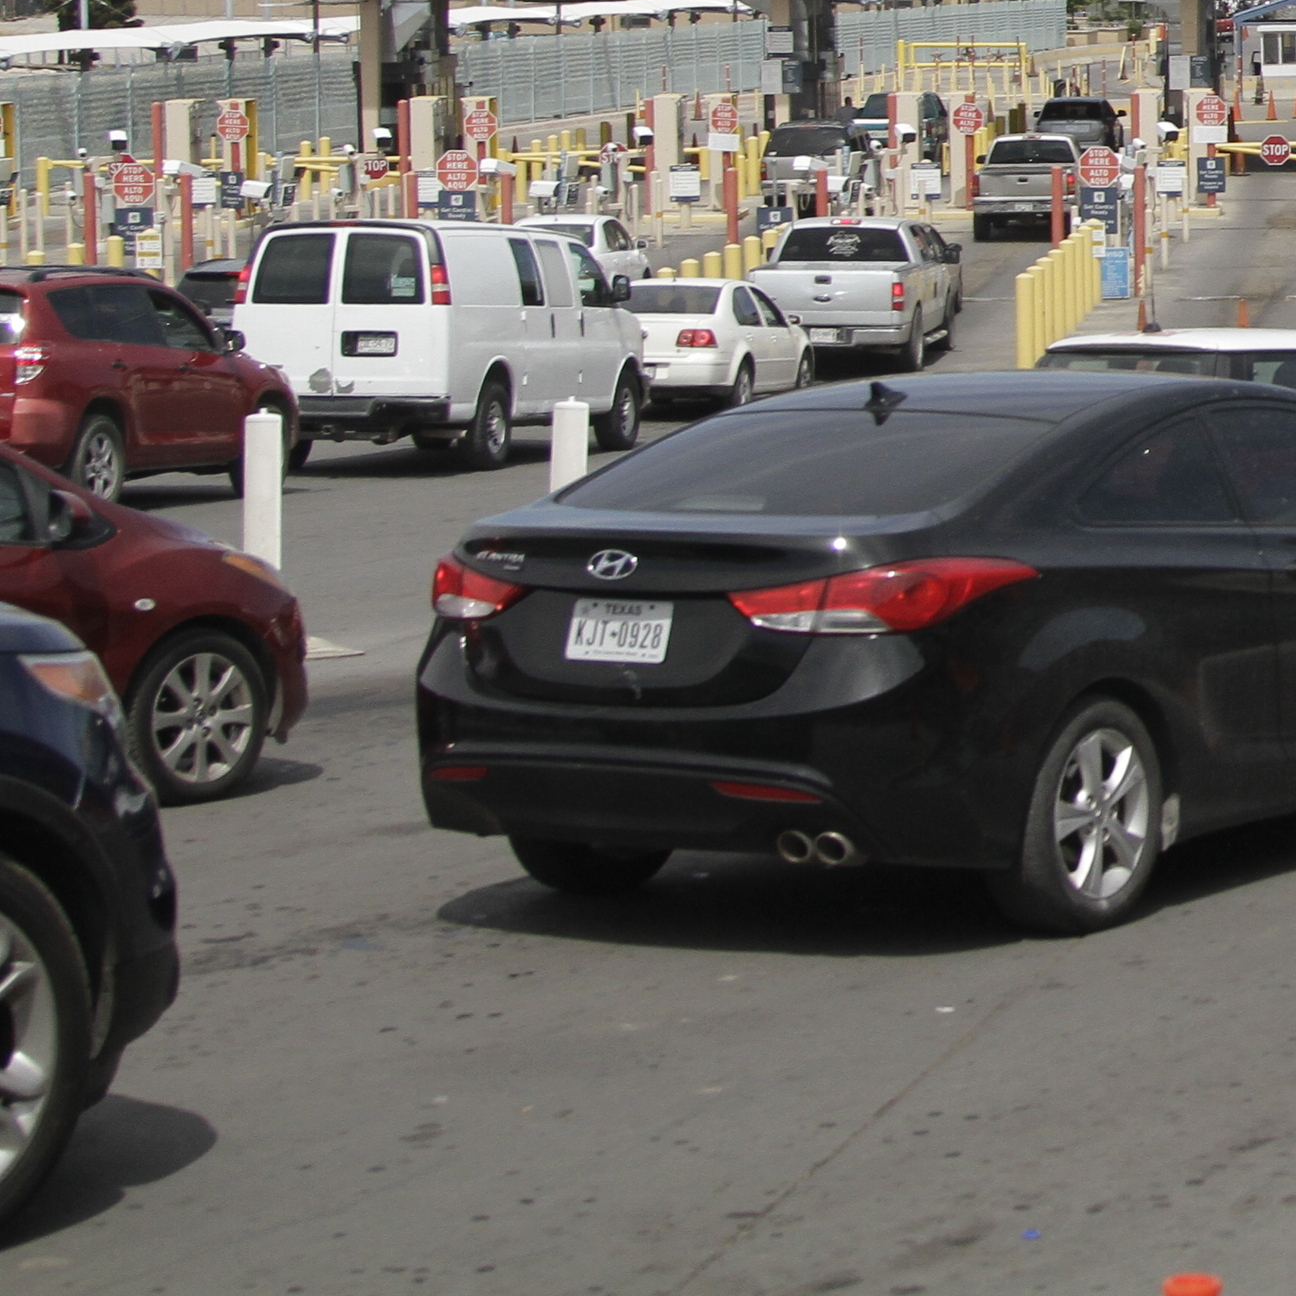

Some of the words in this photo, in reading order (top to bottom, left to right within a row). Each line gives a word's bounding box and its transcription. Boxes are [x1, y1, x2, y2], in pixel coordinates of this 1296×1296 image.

[1262, 144, 1289, 156] STOP
[365, 160, 387, 171] TOP
[446, 161, 468, 169] HERE
[122, 166, 143, 174] STOP
[122, 175, 145, 183] HERE
[605, 603, 642, 616] TEXAS
